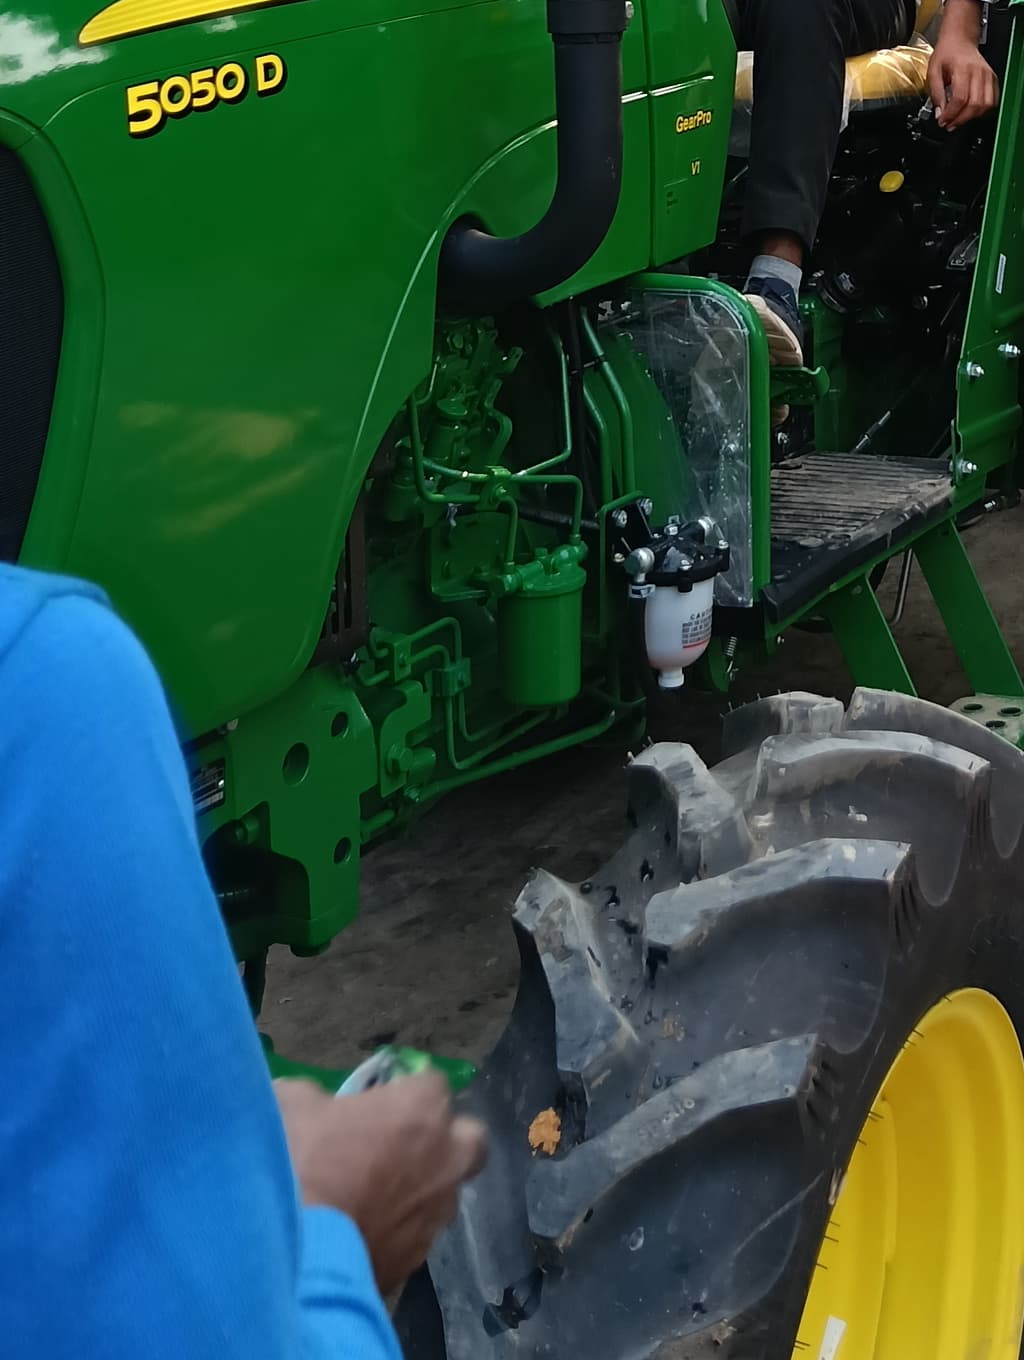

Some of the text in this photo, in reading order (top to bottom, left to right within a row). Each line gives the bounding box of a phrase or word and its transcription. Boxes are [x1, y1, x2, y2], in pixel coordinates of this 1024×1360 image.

[126, 52, 286, 138] 5050 D
[675, 109, 713, 134] GearPro
